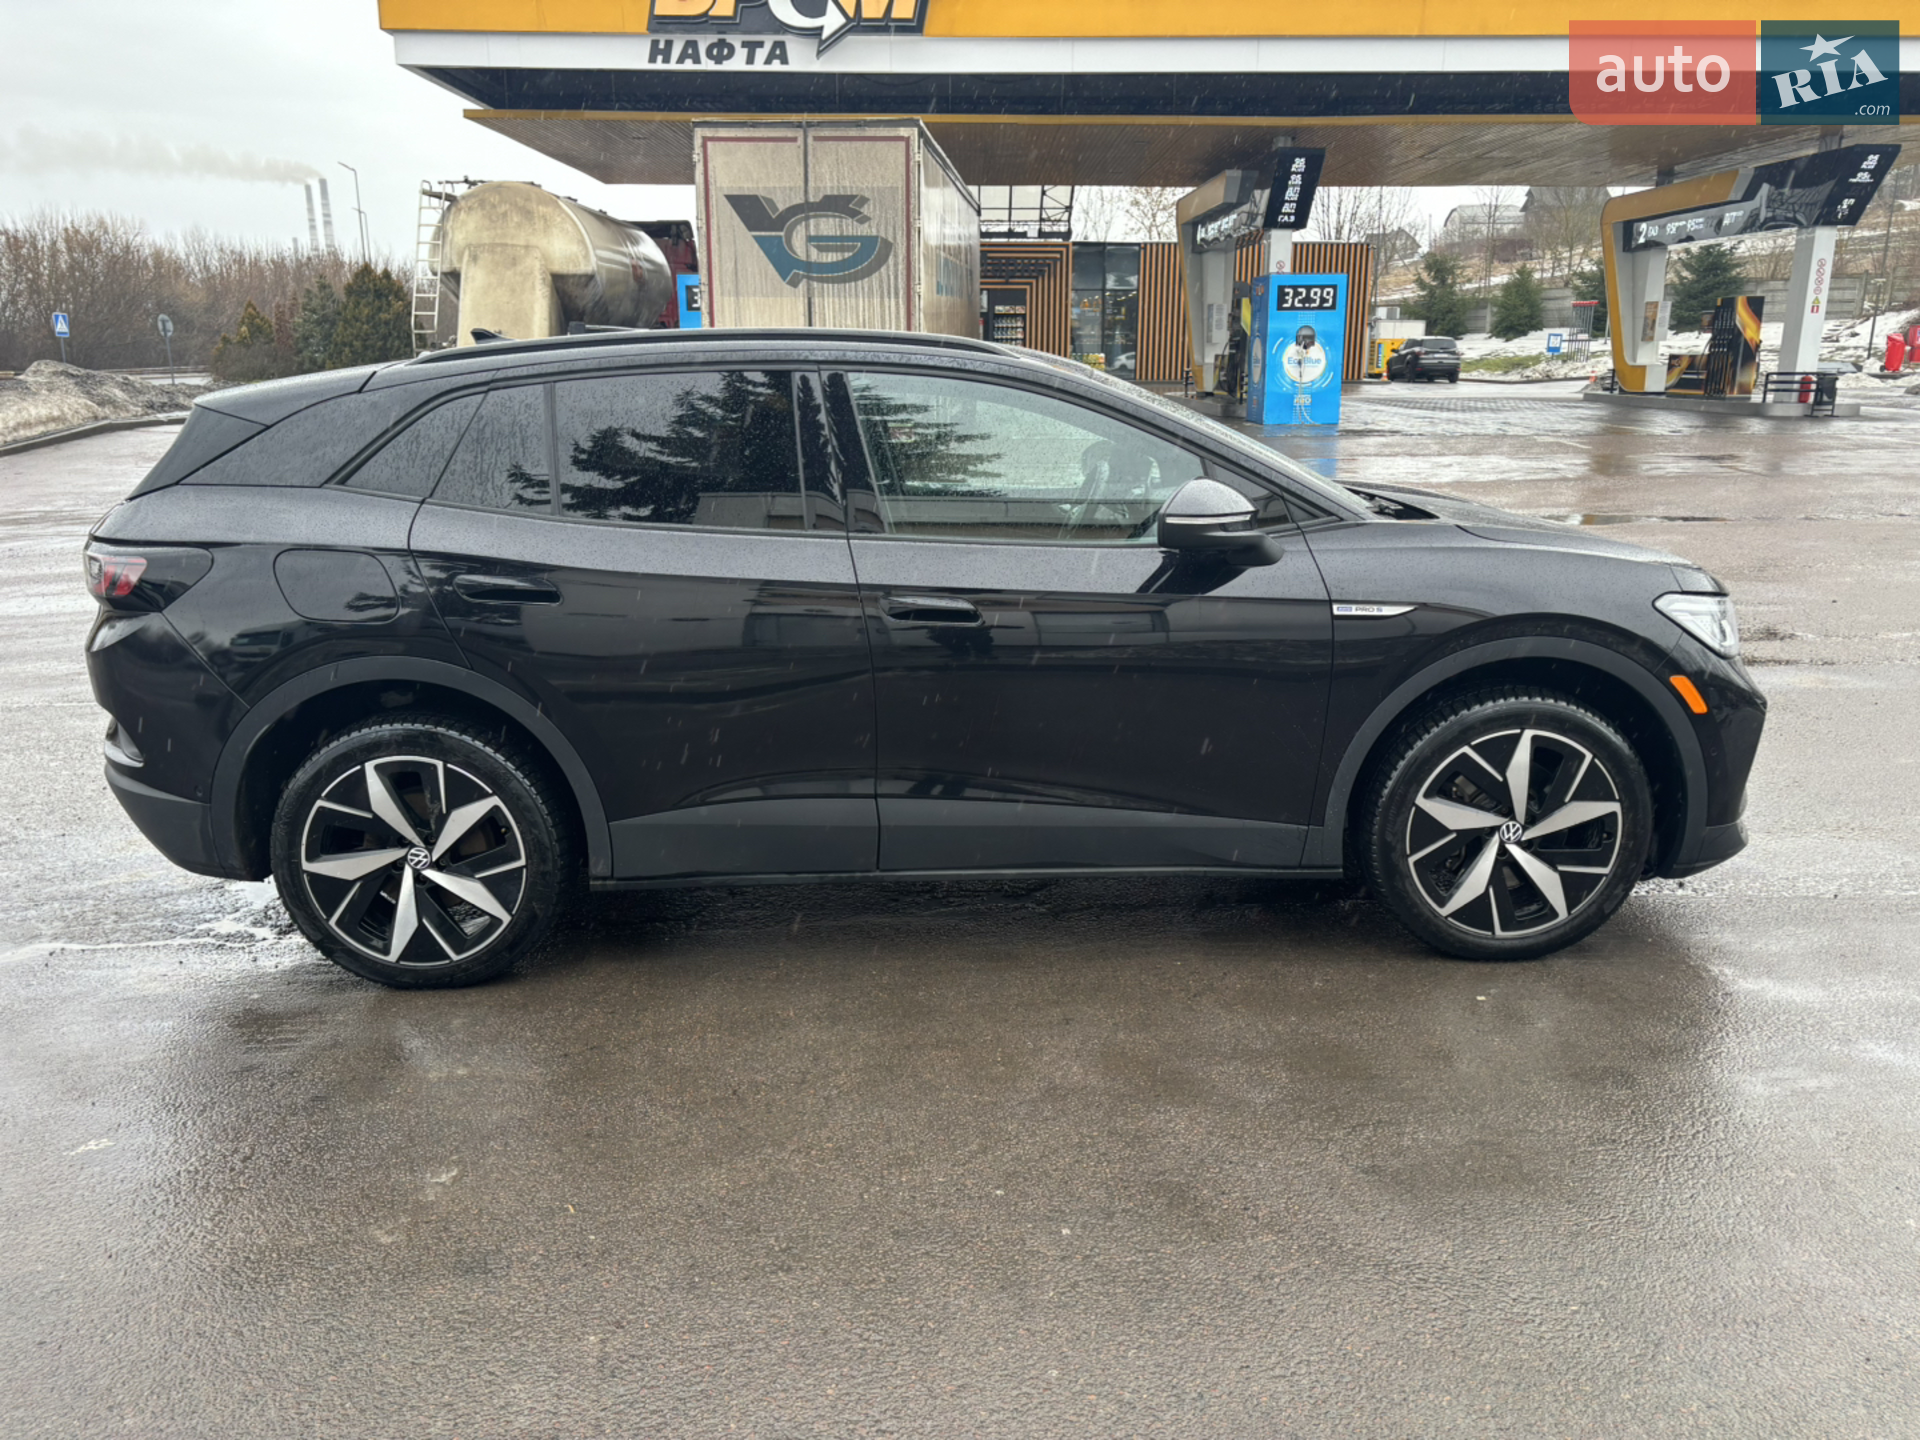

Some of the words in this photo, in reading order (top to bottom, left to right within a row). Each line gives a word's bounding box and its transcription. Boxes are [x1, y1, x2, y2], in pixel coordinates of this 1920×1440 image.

[648, 38, 790, 66] НАФТА
[1638, 223, 1647, 244] 2
[1282, 287, 1334, 308] 32.99
[1287, 356, 1322, 365] EcBlue
